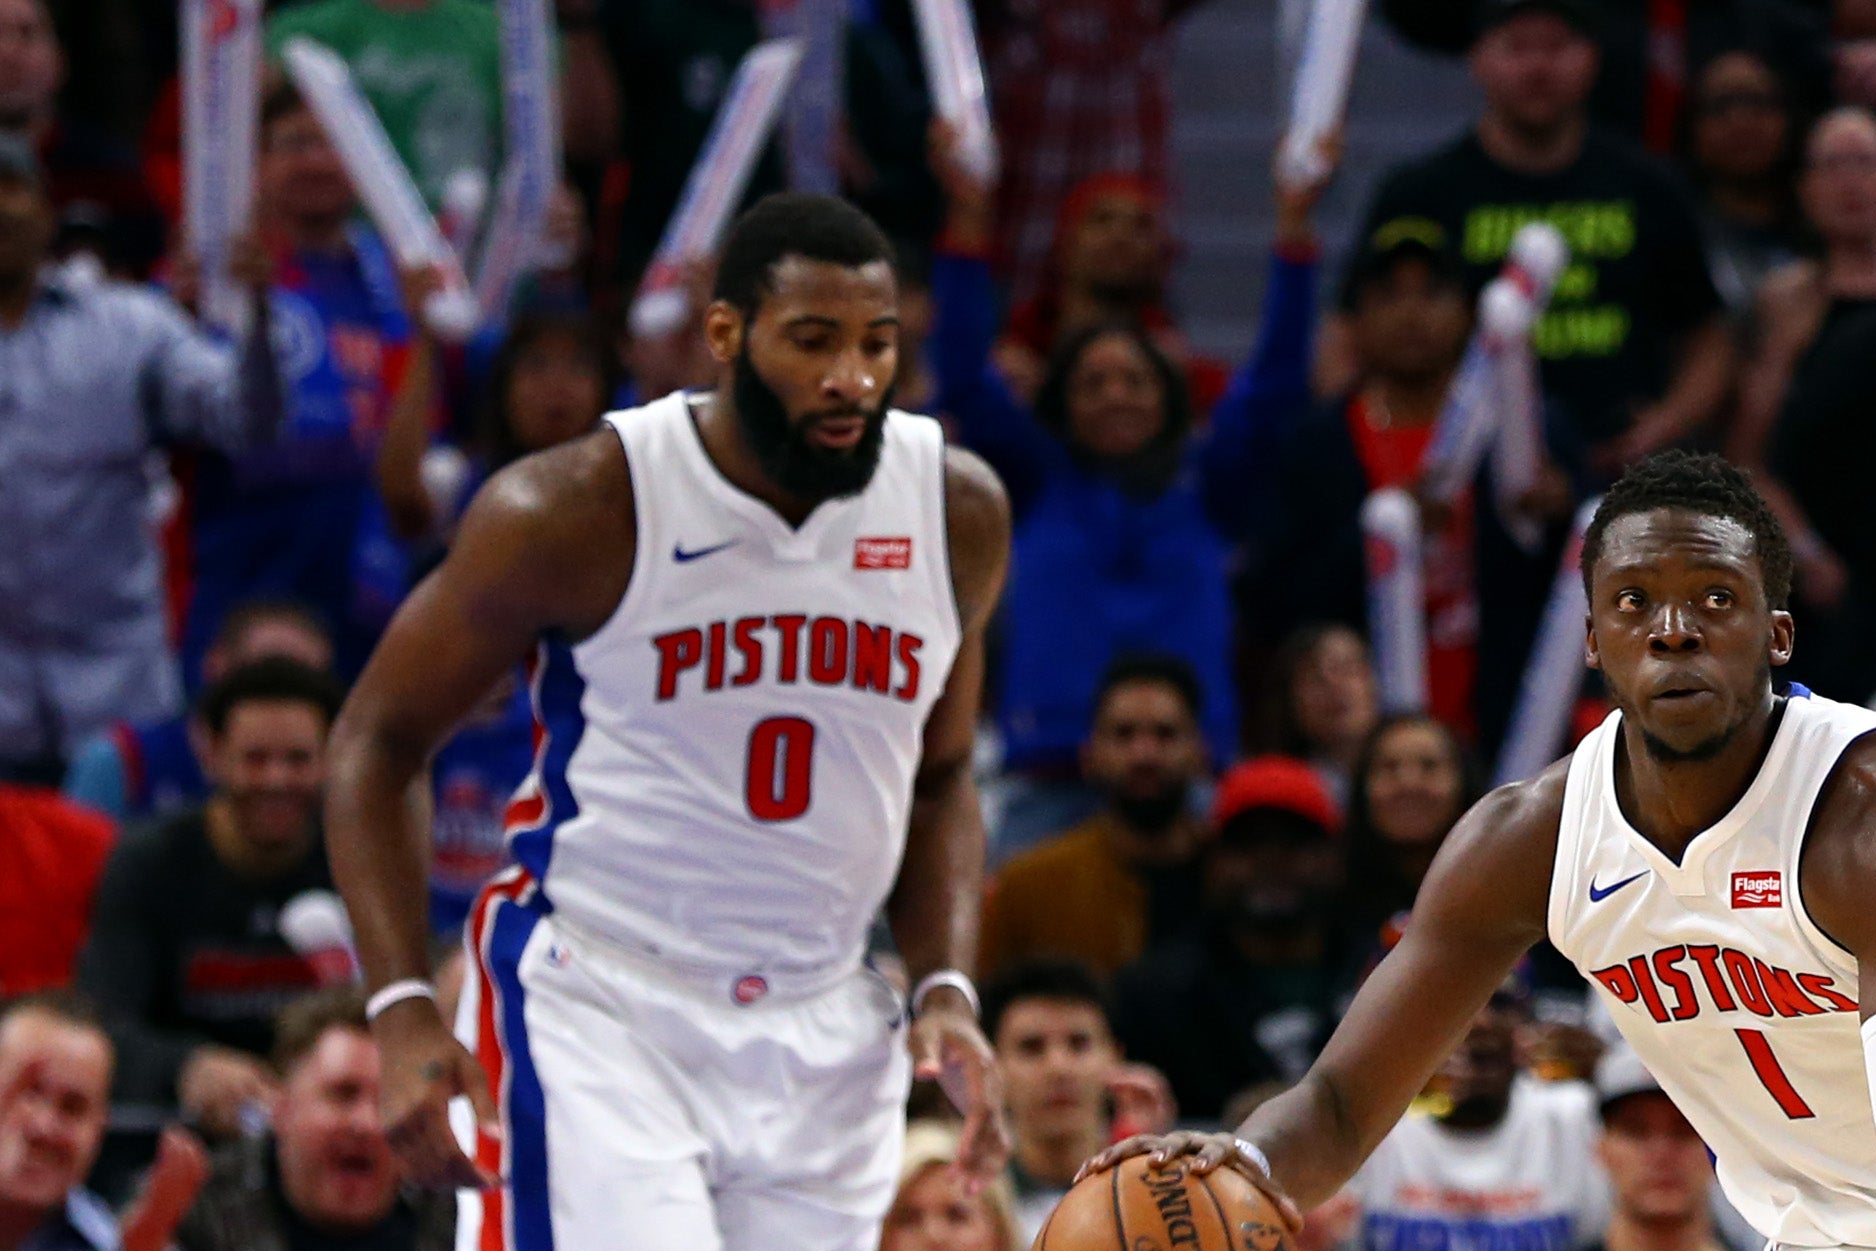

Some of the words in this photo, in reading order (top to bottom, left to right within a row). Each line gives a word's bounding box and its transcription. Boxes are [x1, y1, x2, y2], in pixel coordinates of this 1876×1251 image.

[653, 614, 923, 703] PISTONS
[745, 715, 815, 824] 0
[1735, 876, 1780, 894] Flagsta
[1590, 943, 1860, 1024] PISTONS
[1733, 1028, 1816, 1120] 1
